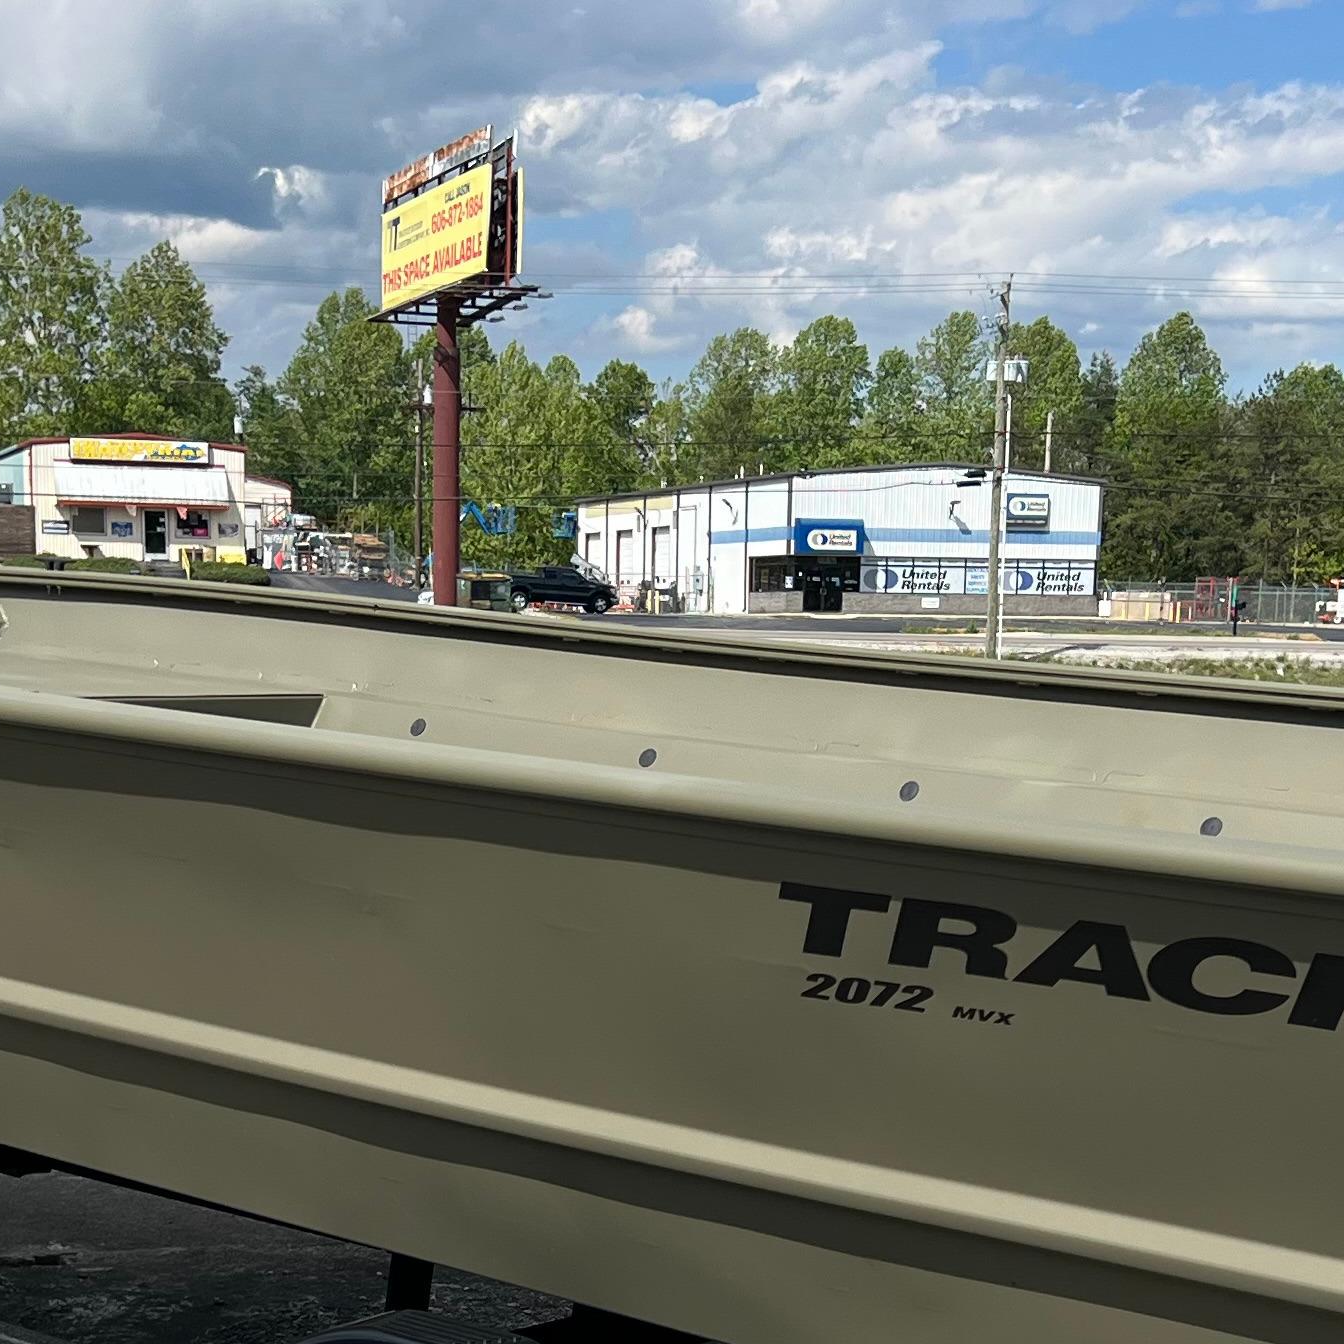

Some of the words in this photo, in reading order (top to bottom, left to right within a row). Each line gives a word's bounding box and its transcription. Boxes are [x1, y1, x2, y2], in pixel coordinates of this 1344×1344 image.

[384, 267, 401, 294] THIS
[404, 254, 430, 286] SPACE
[432, 232, 482, 275] AVAILABLE
[901, 569, 947, 580] United
[1036, 571, 1081, 581] United
[901, 580, 950, 590] Rentals
[1036, 581, 1084, 592] Rentals
[800, 973, 935, 1013] 2072
[952, 1006, 1015, 1026] MVX
